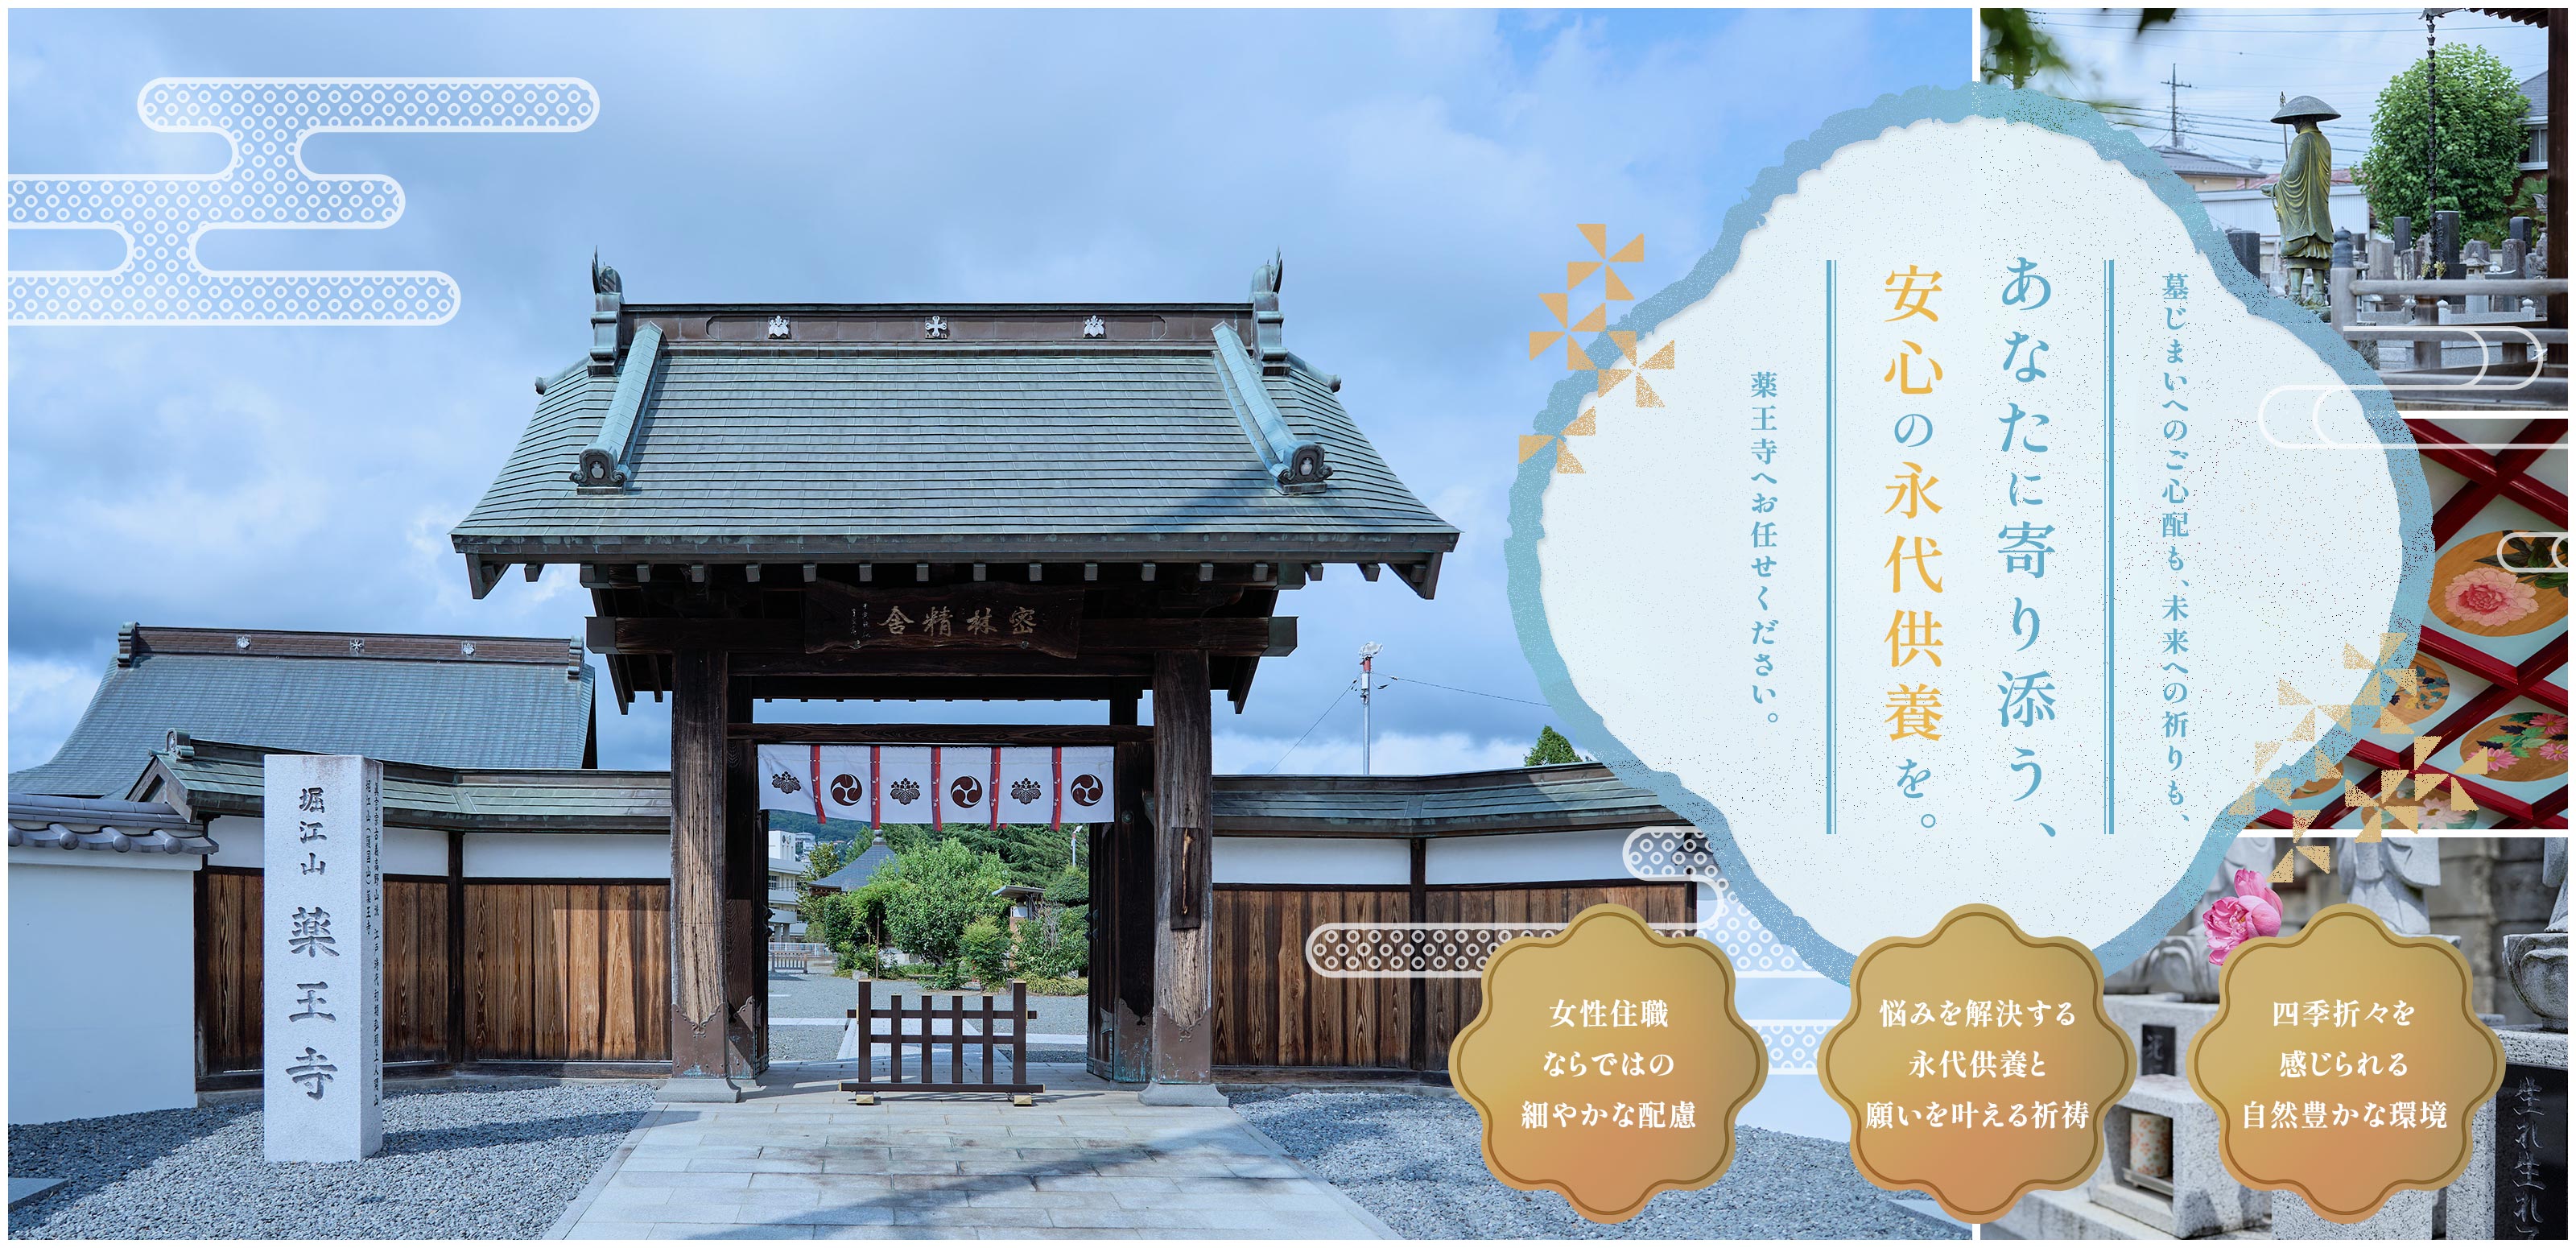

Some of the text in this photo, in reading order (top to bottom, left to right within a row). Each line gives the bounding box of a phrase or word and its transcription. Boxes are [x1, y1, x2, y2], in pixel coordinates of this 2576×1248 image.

[286, 787, 340, 1101] 堀江山 薬王寺
